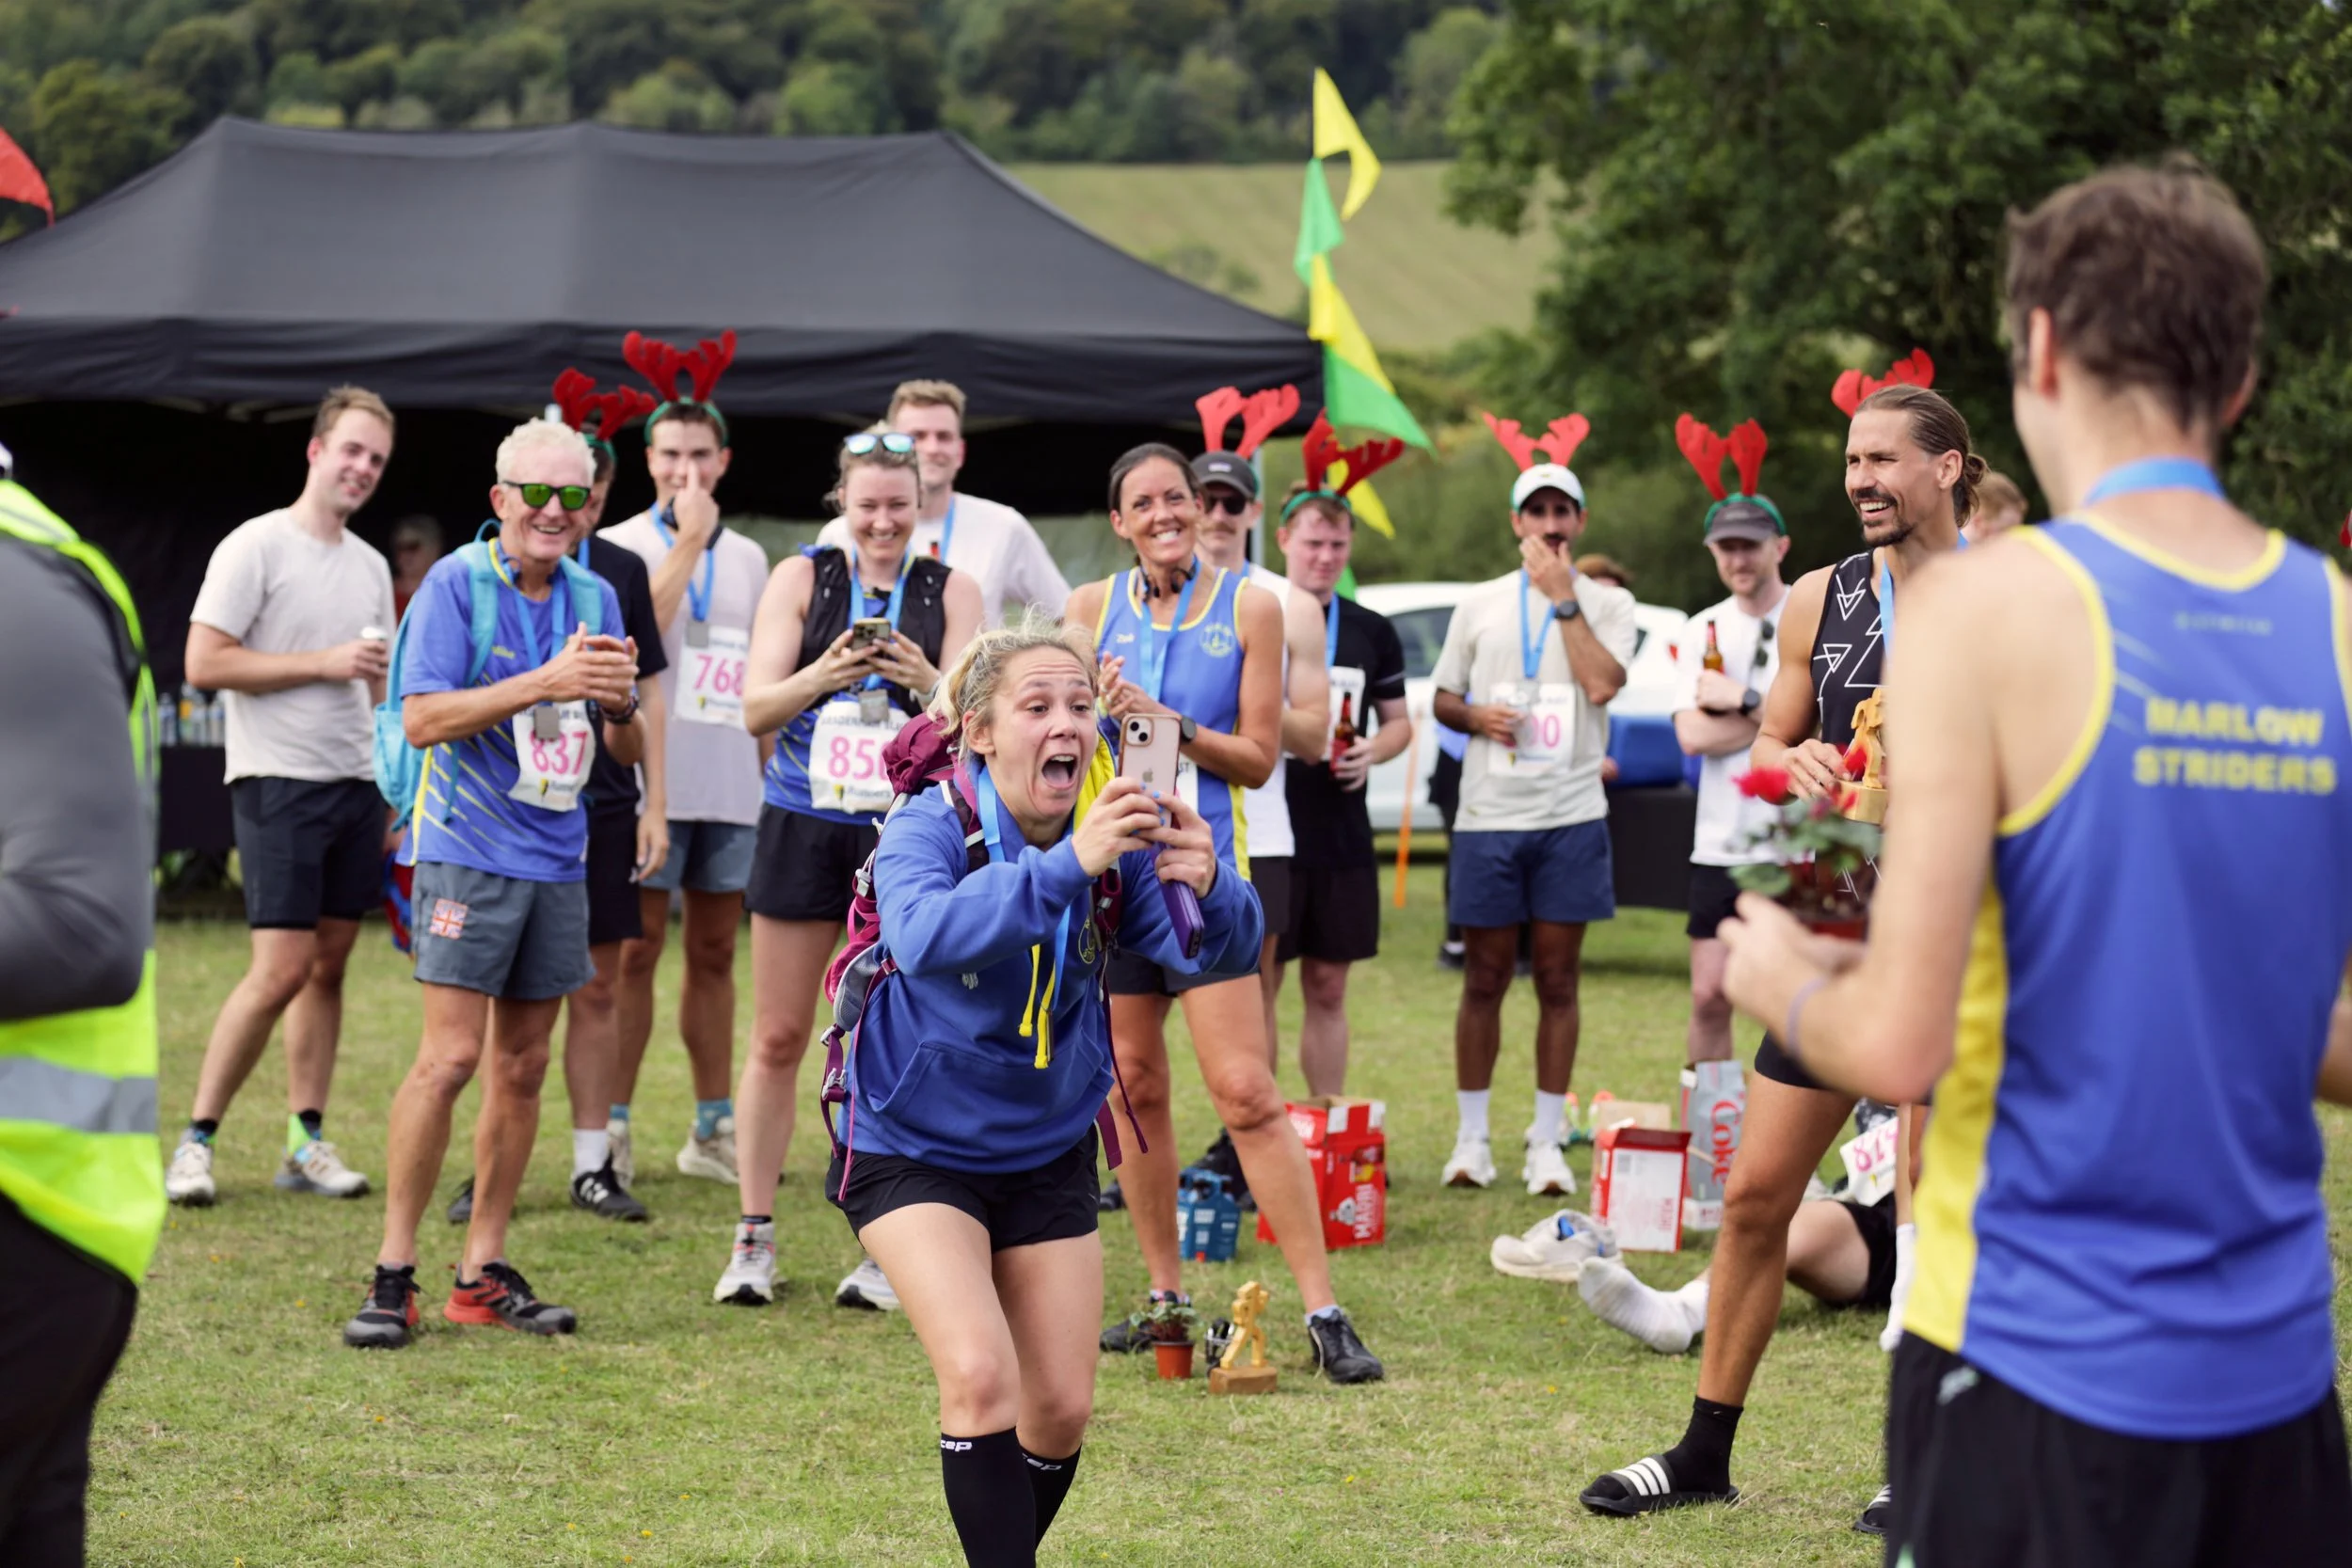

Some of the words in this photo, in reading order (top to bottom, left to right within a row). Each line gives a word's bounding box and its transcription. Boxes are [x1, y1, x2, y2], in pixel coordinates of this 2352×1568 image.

[2146, 696, 2324, 747] MARLOW
[529, 729, 589, 775] 837
[2134, 746, 2337, 796] STRIDERS
